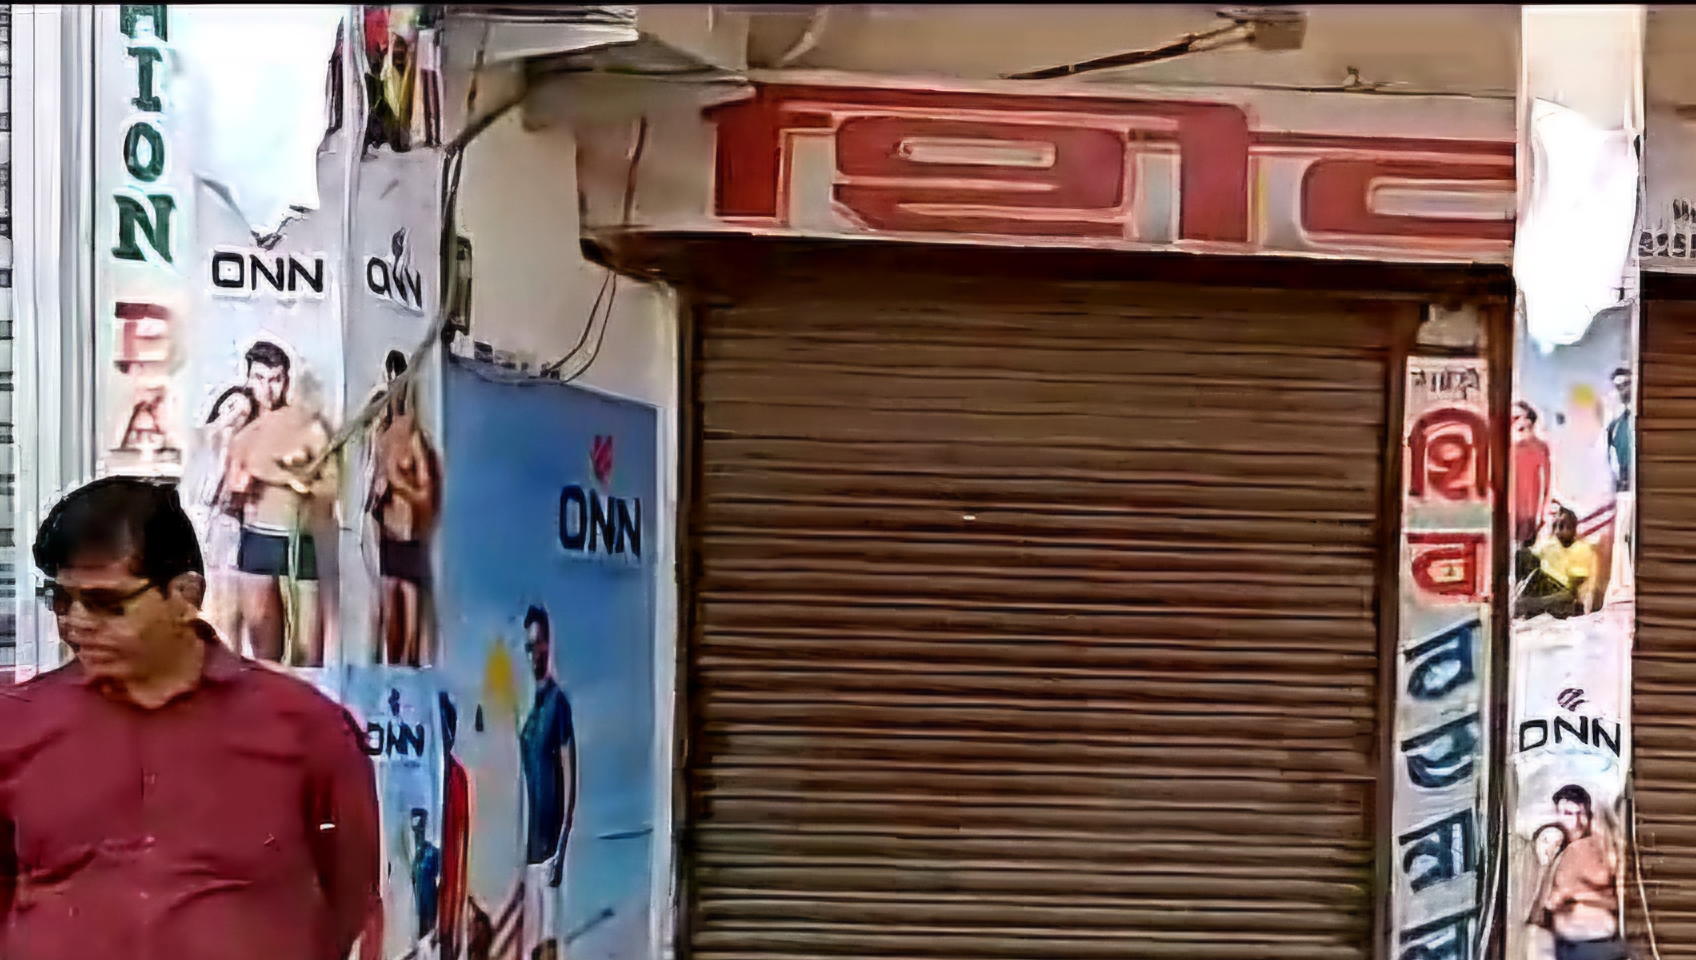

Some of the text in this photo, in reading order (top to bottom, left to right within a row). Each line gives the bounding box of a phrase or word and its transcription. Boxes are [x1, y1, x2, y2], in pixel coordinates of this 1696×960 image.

[211, 251, 324, 293] ONN
[559, 484, 641, 560] ONN
[1518, 715, 1621, 757] ONN
